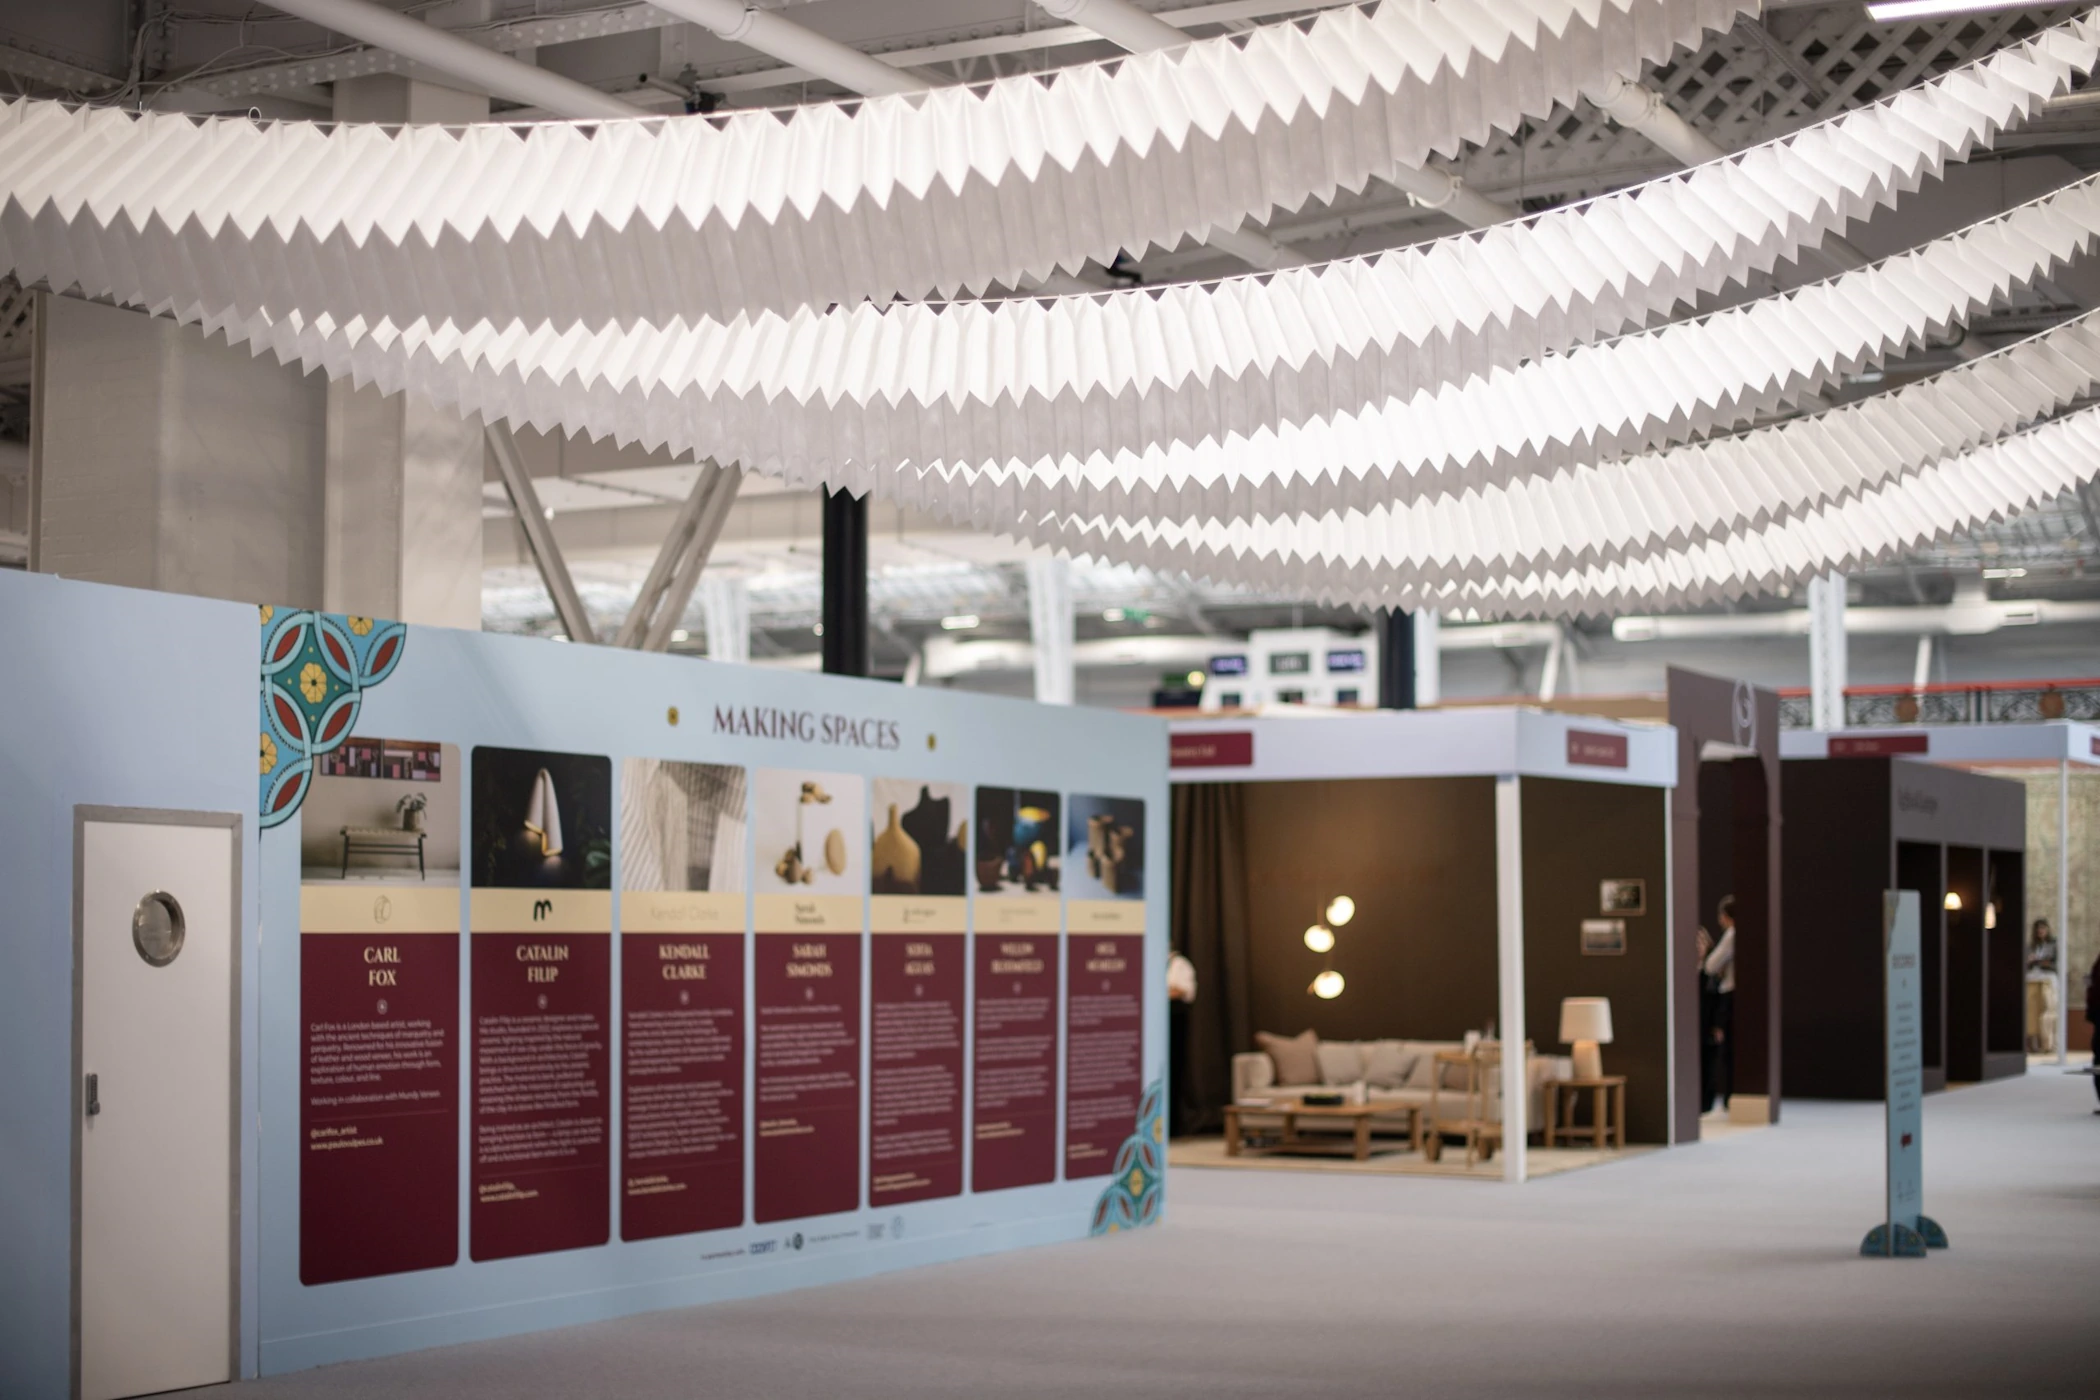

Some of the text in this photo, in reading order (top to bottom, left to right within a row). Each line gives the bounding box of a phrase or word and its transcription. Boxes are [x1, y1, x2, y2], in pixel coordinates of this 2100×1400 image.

[713, 704, 900, 751] MAKING SPACES
[364, 947, 401, 963] CARL
[516, 945, 570, 961] CATALIN
[659, 944, 710, 960] KENDALL
[369, 969, 397, 986] FOX
[527, 966, 559, 982] FILIP
[662, 964, 707, 980] CLARKE
